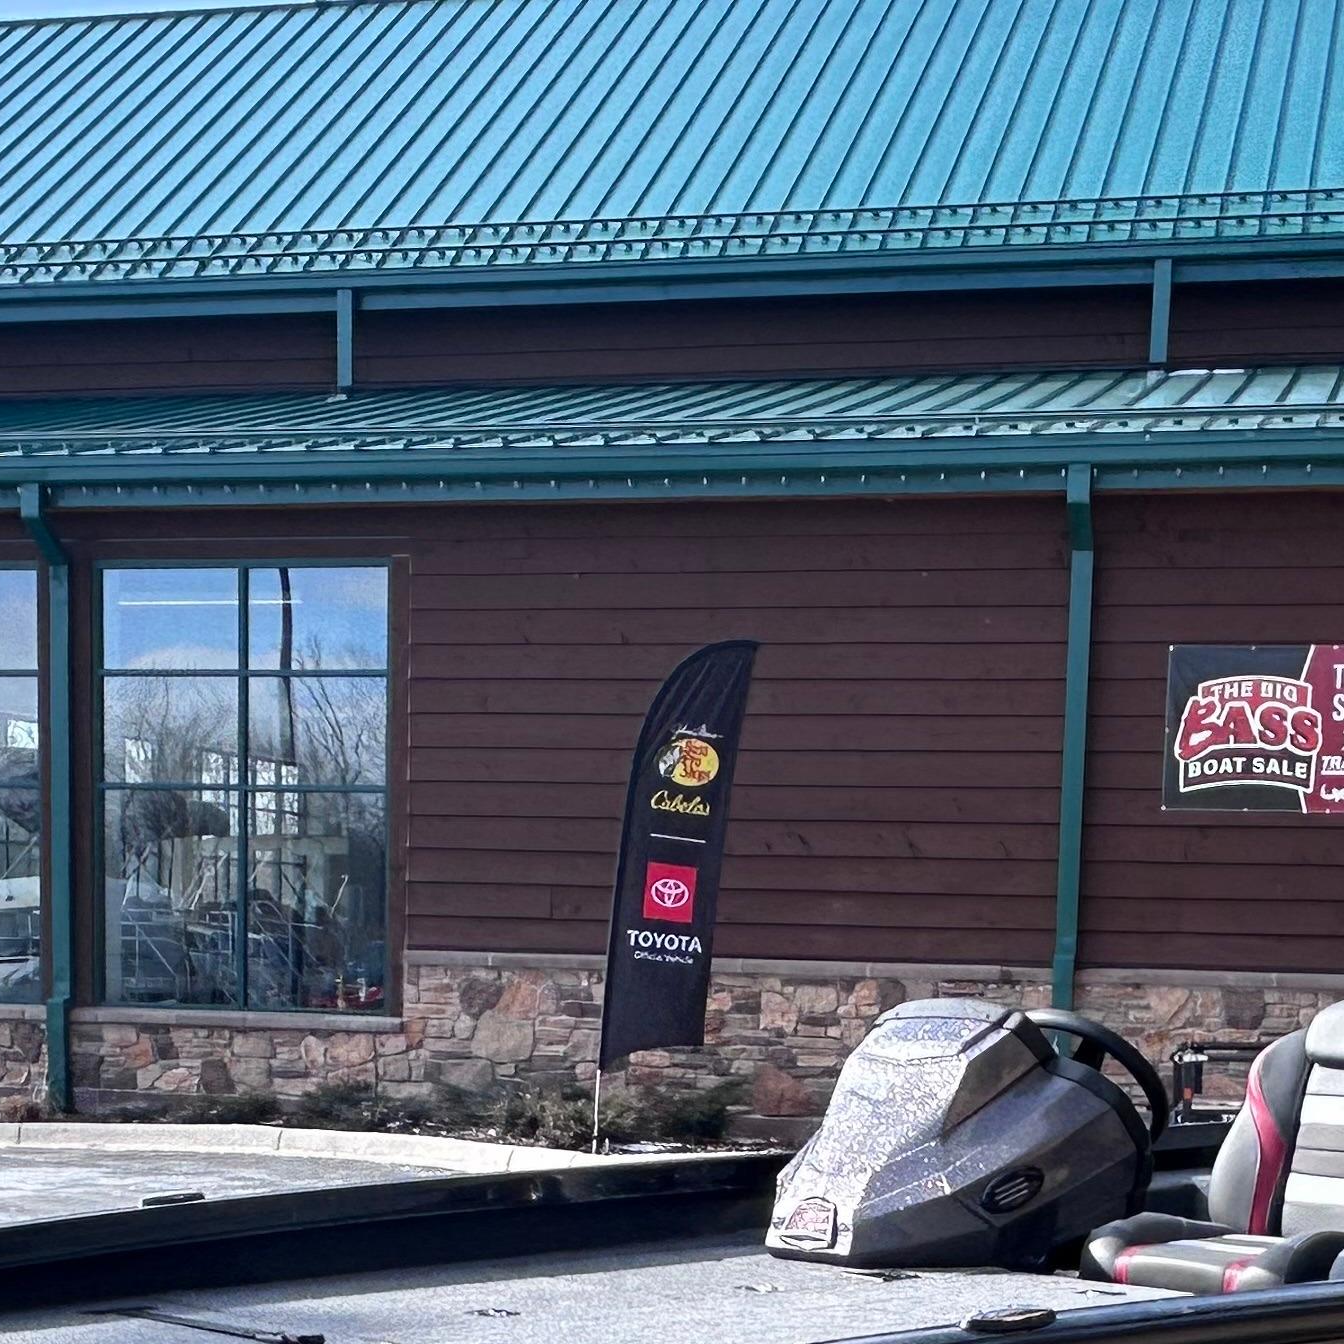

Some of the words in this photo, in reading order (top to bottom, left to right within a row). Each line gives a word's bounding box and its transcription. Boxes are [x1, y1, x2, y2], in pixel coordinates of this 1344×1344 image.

[1210, 681, 1254, 699] THE
[1176, 697, 1321, 761] BASS
[1187, 757, 1247, 779] BOAT
[1252, 757, 1308, 779] SALE
[626, 929, 702, 953] TOYOTA
